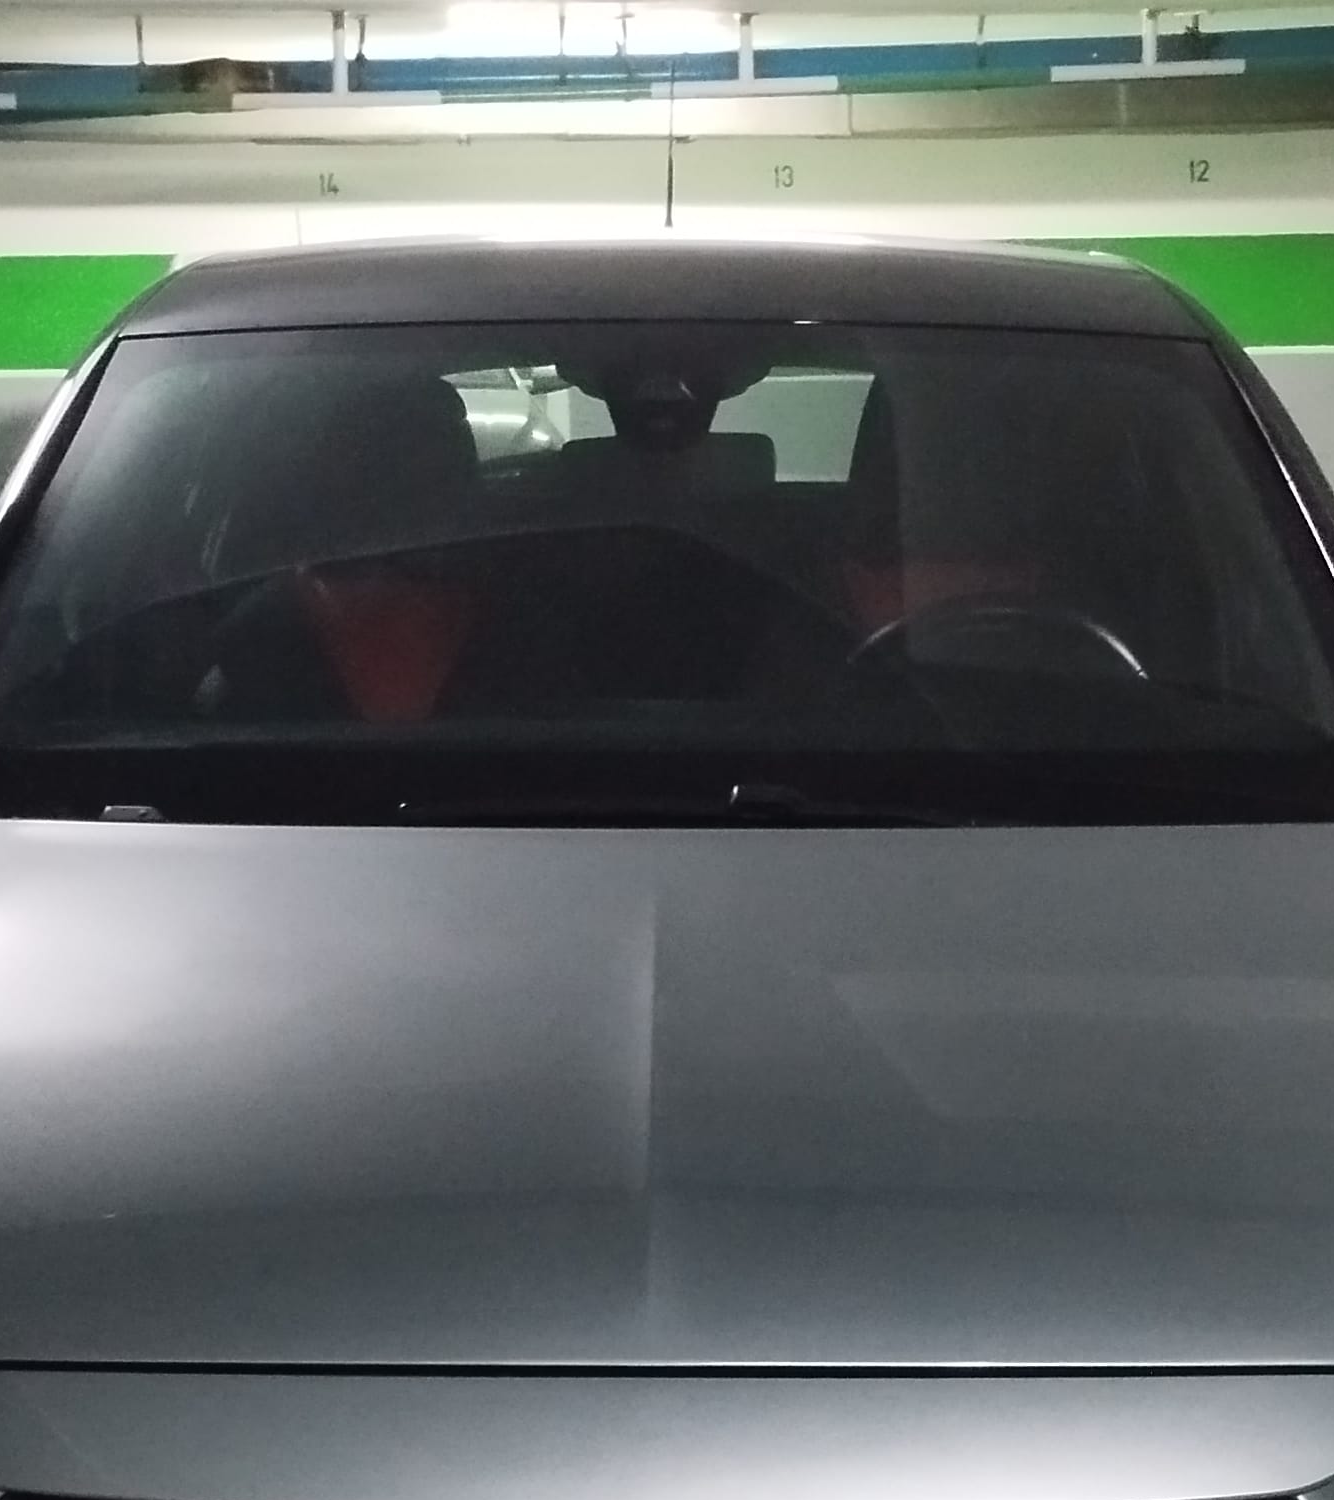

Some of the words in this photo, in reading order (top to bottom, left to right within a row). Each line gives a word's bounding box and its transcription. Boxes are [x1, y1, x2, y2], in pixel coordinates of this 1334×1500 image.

[774, 164, 794, 189] 13
[1189, 159, 1210, 183] 12
[319, 172, 340, 197] 14
